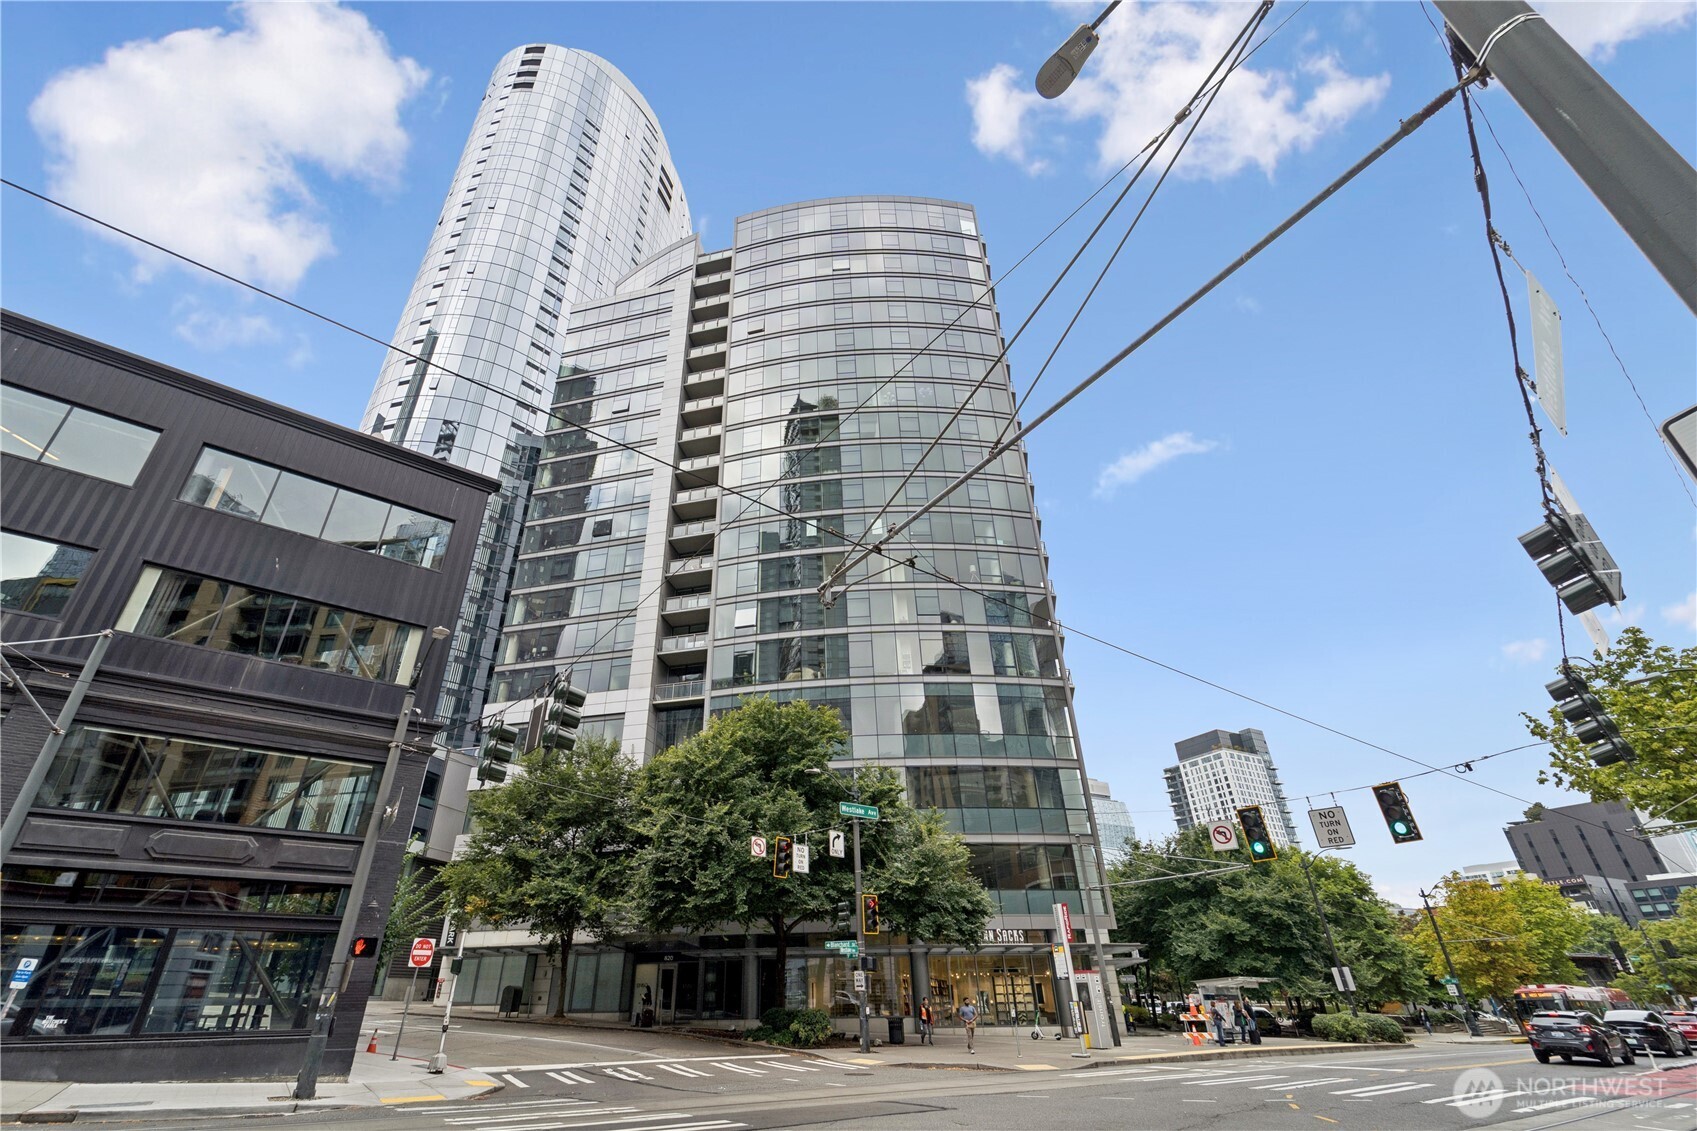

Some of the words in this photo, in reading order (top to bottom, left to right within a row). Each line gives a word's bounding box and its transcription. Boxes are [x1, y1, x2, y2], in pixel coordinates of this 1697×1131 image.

[841, 805, 865, 815] Westlake
[868, 809, 877, 817] Ave
[1318, 810, 1336, 820] NO
[1319, 819, 1342, 829] TURN
[1327, 828, 1339, 836] ON
[1327, 836, 1345, 845] RED
[831, 848, 843, 856] ONLY
